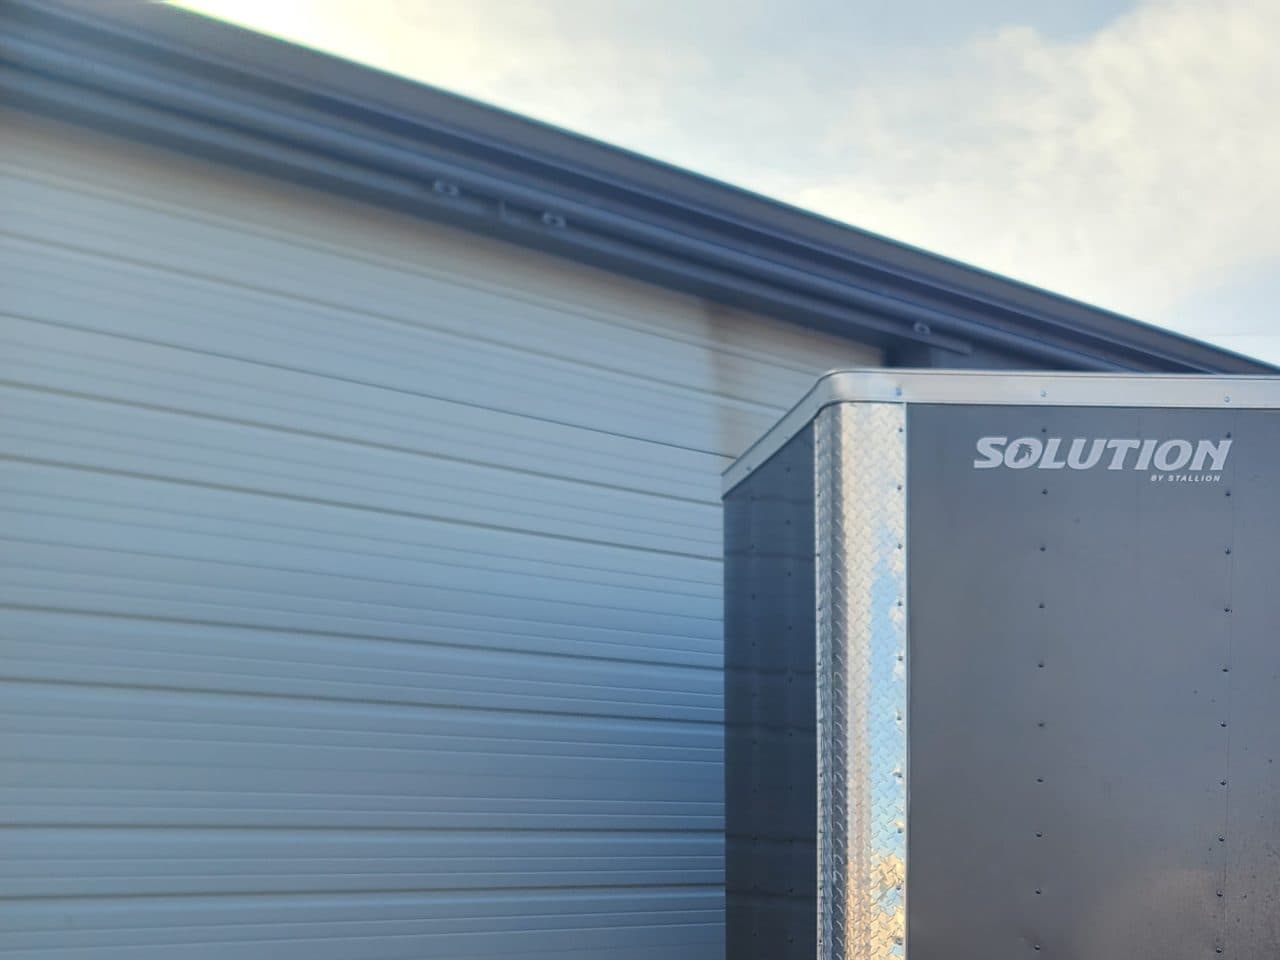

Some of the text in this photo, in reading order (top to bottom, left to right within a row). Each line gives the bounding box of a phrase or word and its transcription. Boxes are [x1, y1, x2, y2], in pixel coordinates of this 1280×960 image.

[973, 437, 1233, 472] SOLUTION
[1150, 474, 1221, 482] BY STALLION
